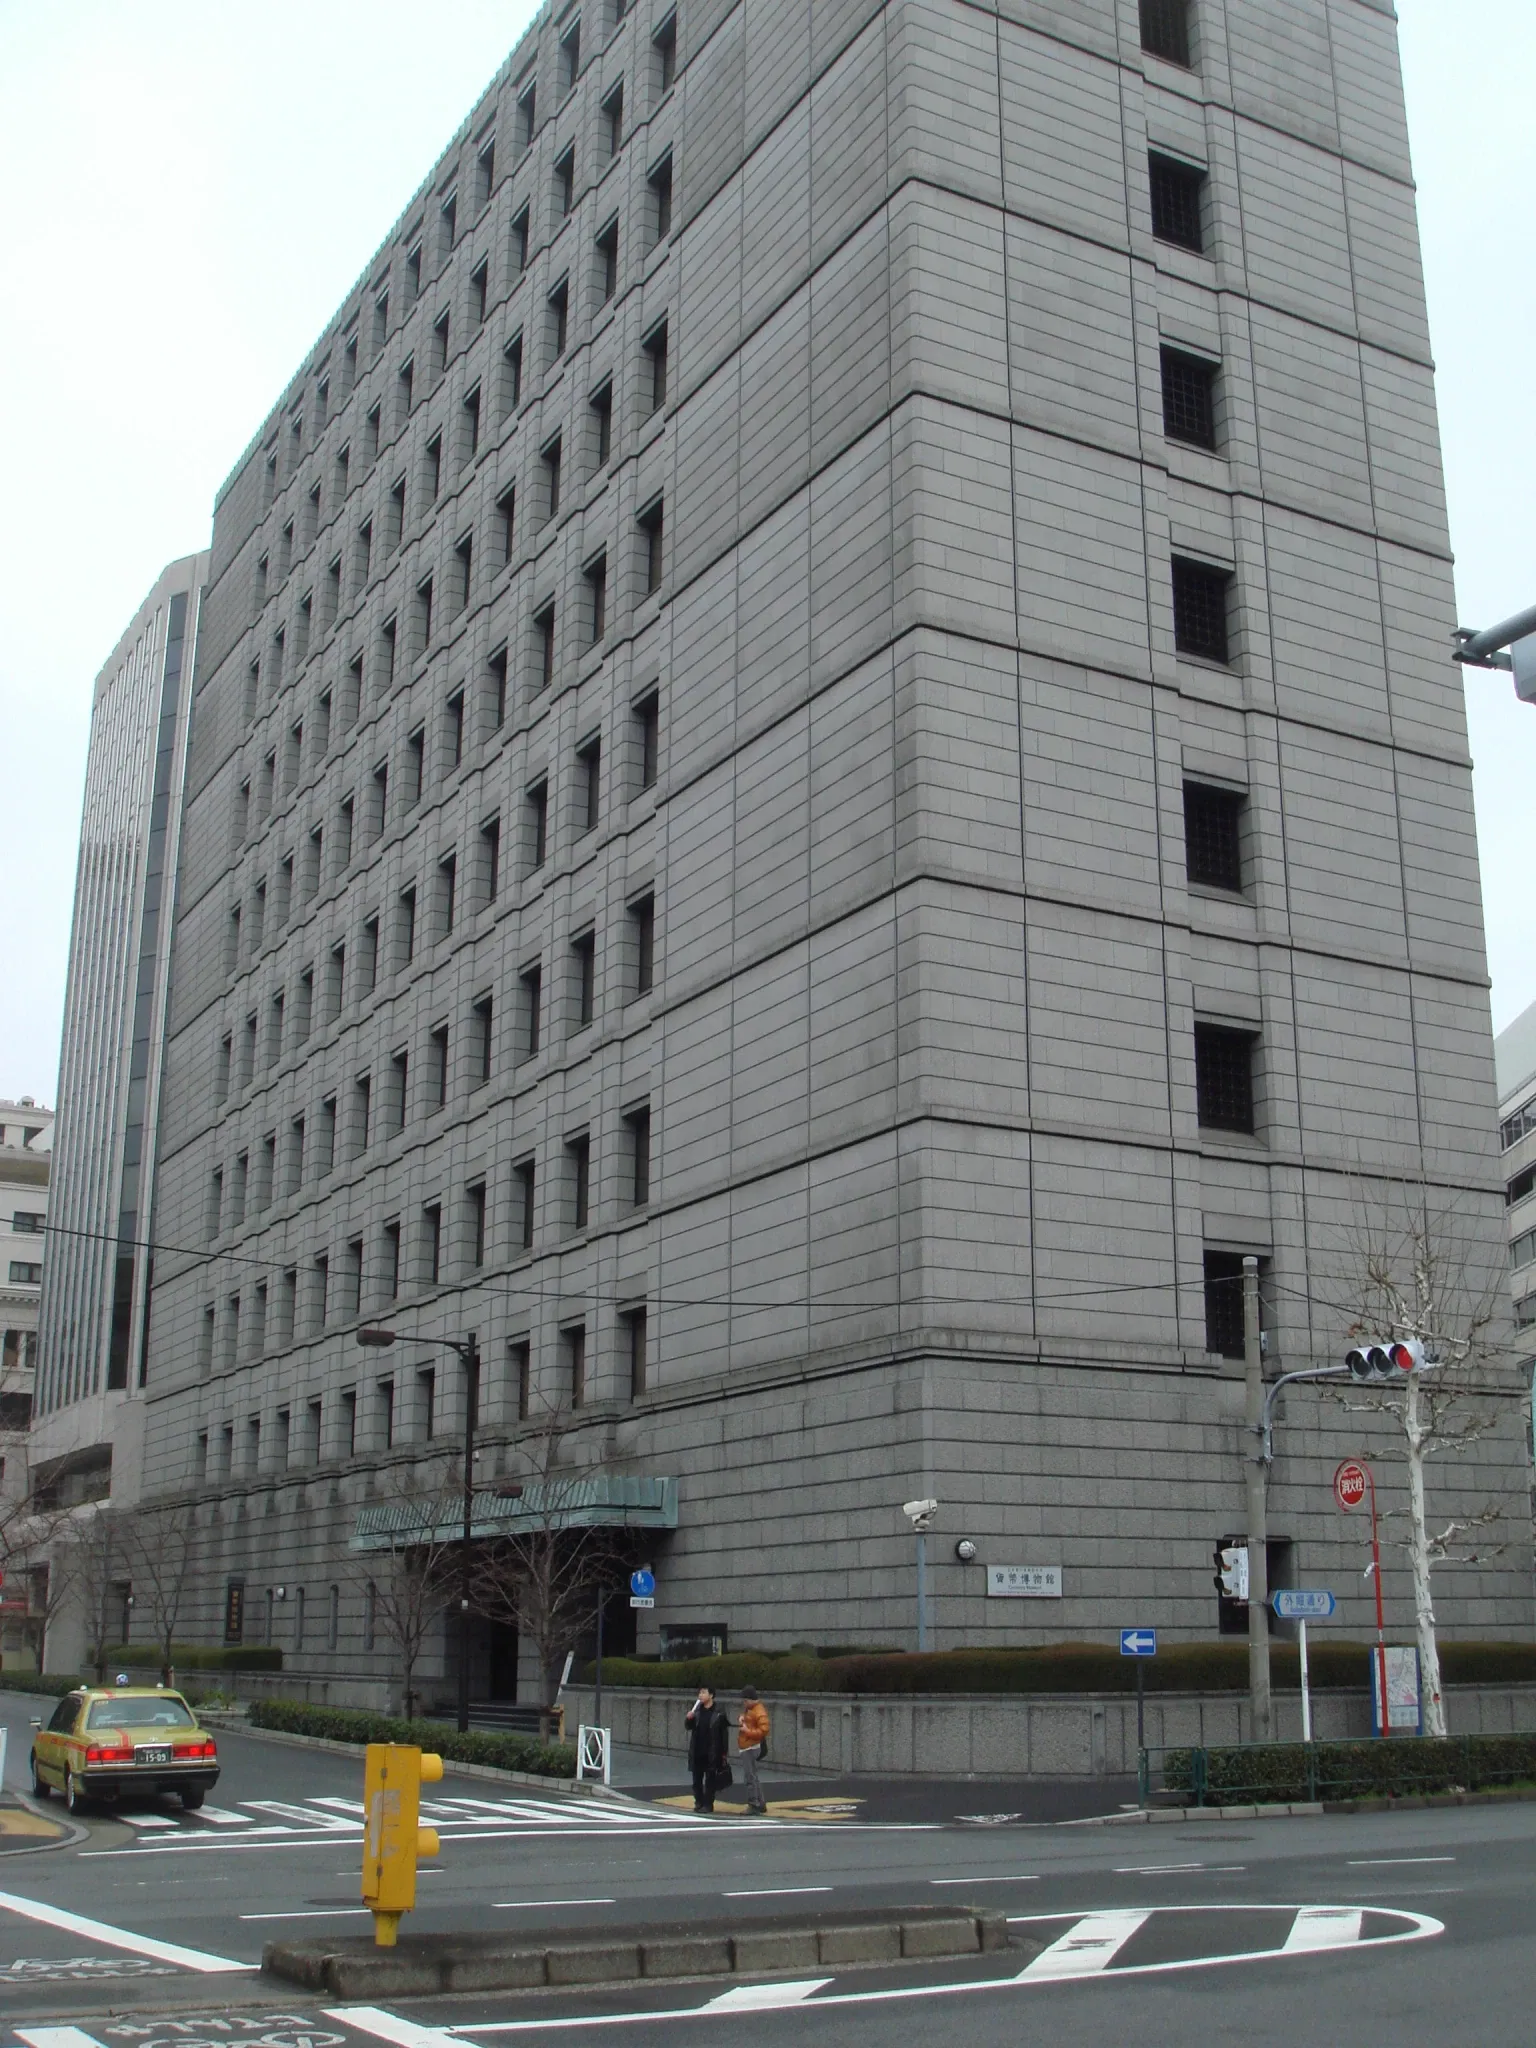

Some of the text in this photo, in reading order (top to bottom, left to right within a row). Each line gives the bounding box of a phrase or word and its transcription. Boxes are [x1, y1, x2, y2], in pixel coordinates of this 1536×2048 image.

[1341, 1477, 1363, 1494] 消火栓
[145, 1753, 167, 1763] 15-09
